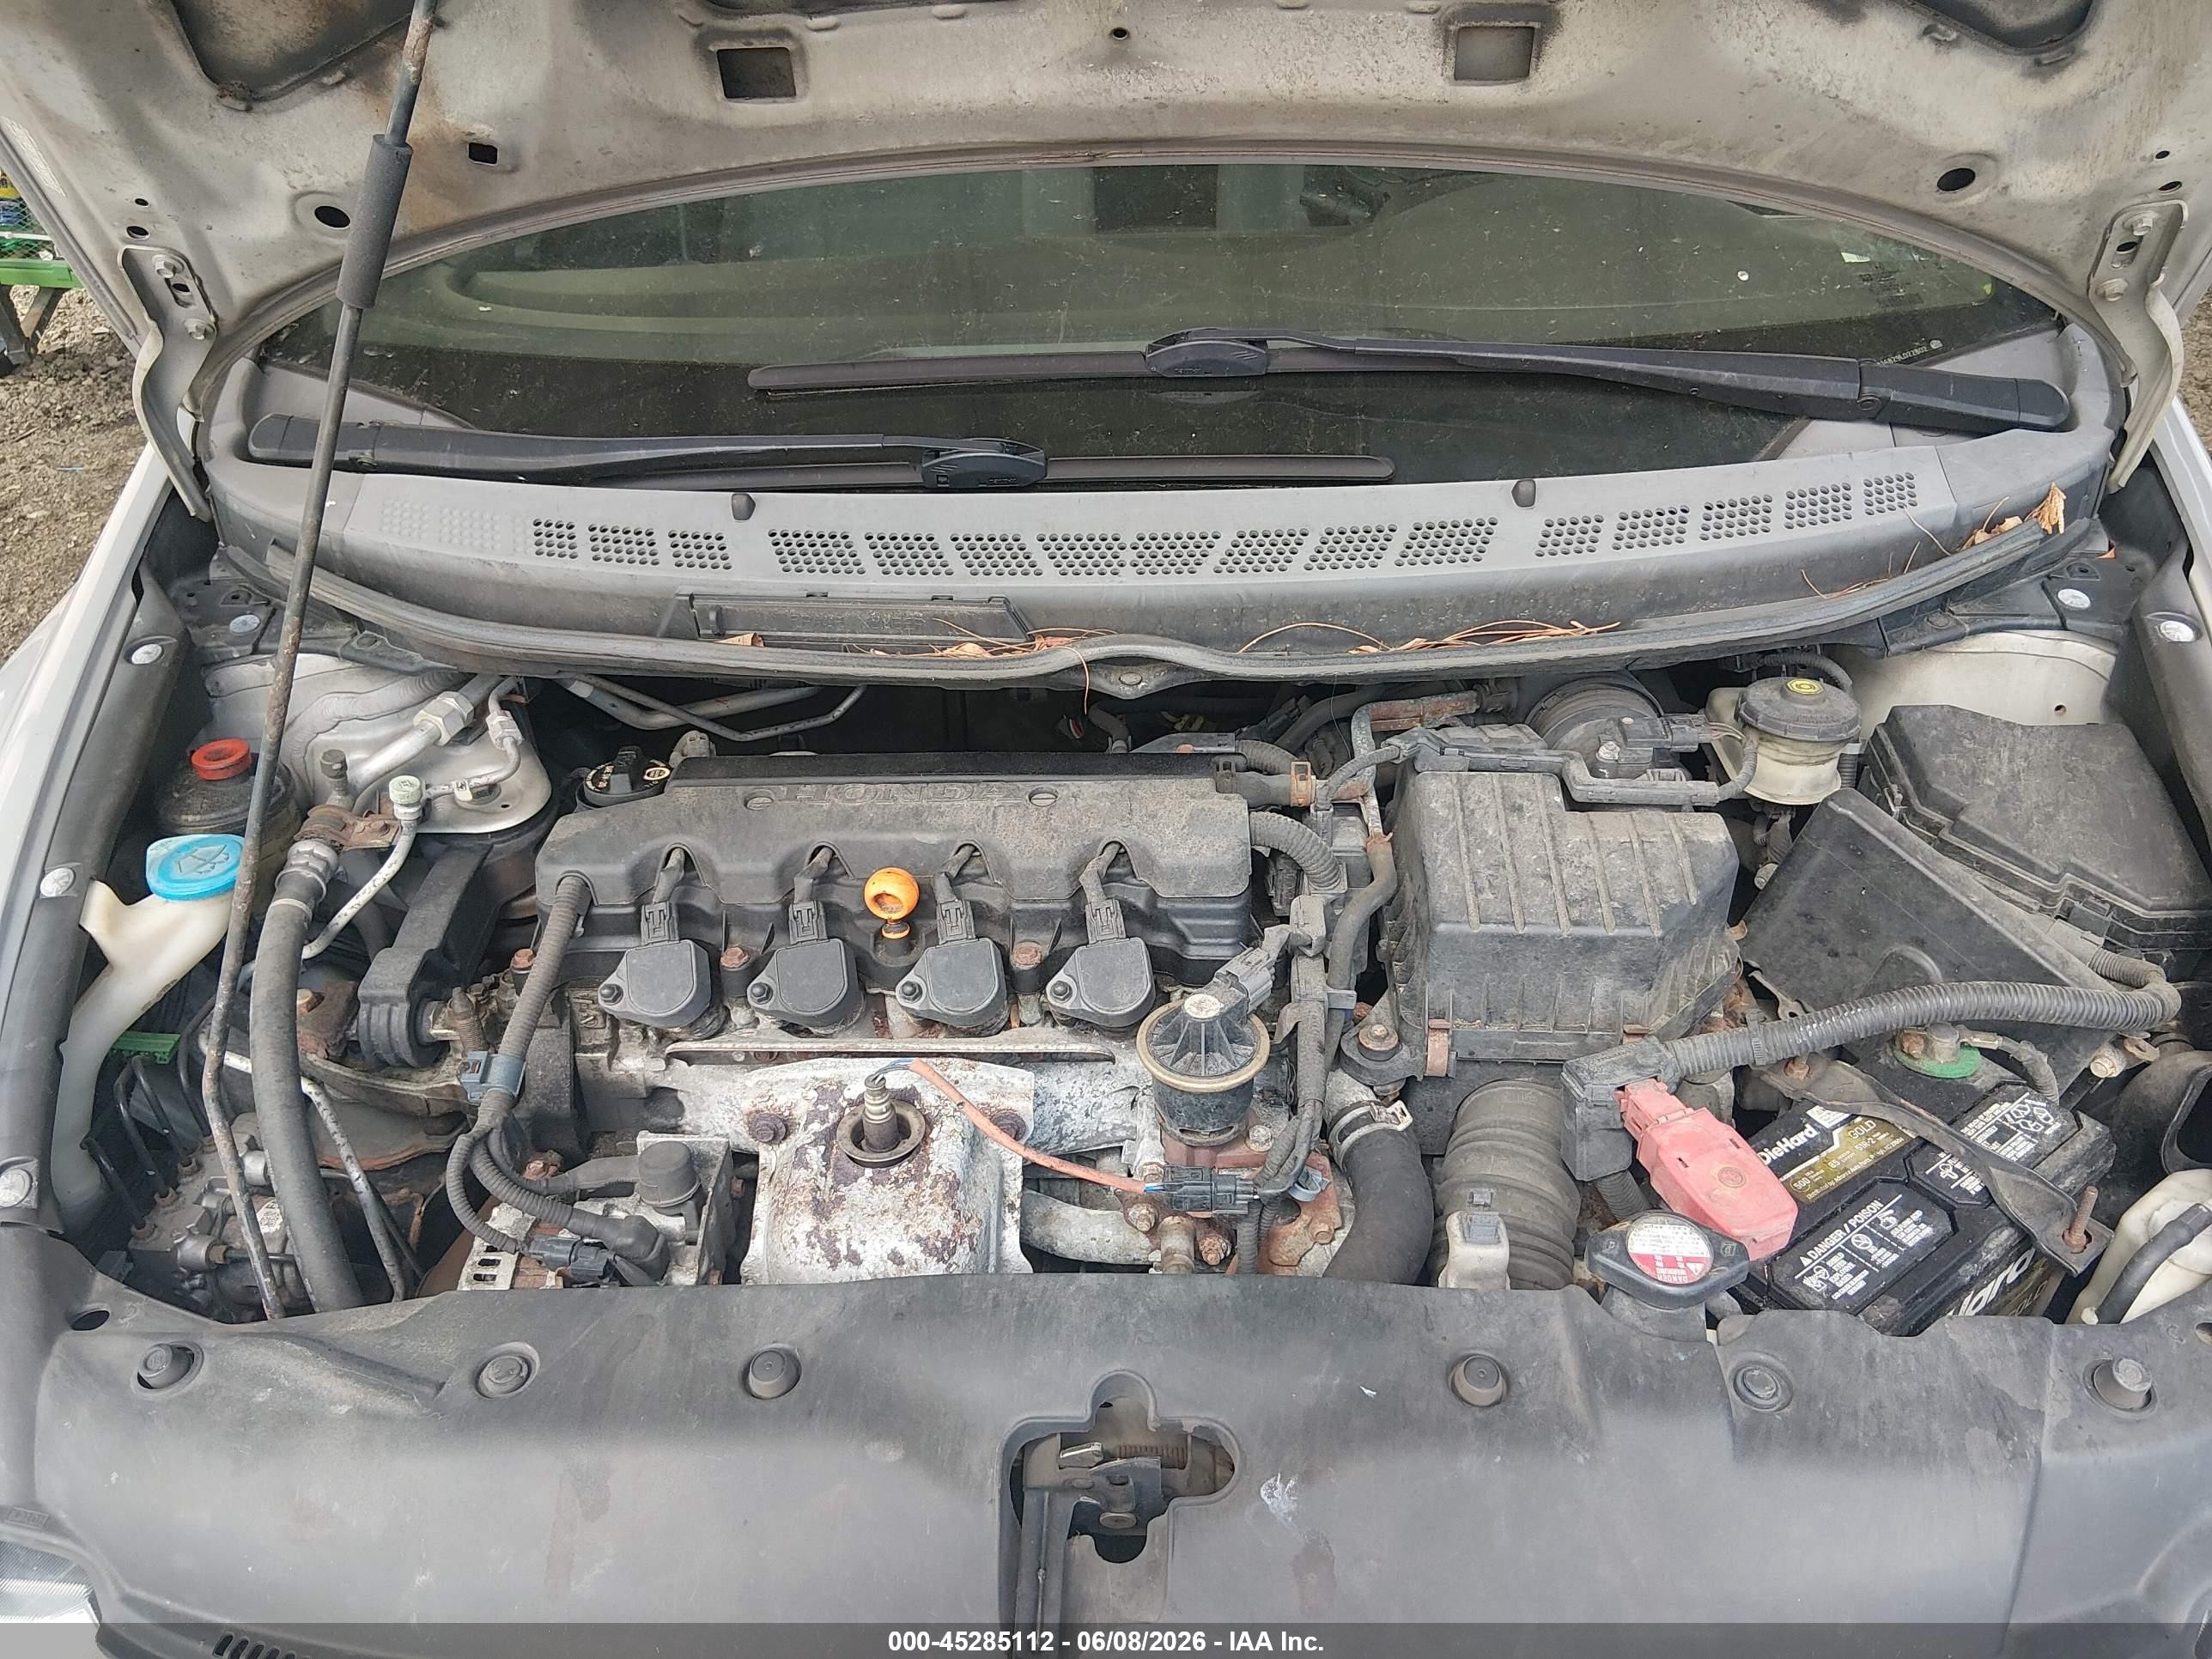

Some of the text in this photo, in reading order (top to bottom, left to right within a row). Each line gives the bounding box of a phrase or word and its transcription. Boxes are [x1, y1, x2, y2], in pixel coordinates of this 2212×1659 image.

[781, 781, 1025, 805] HONDA
[1848, 1119, 1876, 1140] GOLD
[1757, 1123, 1820, 1164] DieHard
[1793, 1177, 1810, 1190] 500
[1807, 1229, 1845, 1261] DANGER
[1848, 1200, 1884, 1229] POISON
[1656, 1274, 1688, 1284] DANGER
[1828, 1261, 1856, 1285] EXPLOSIVE
